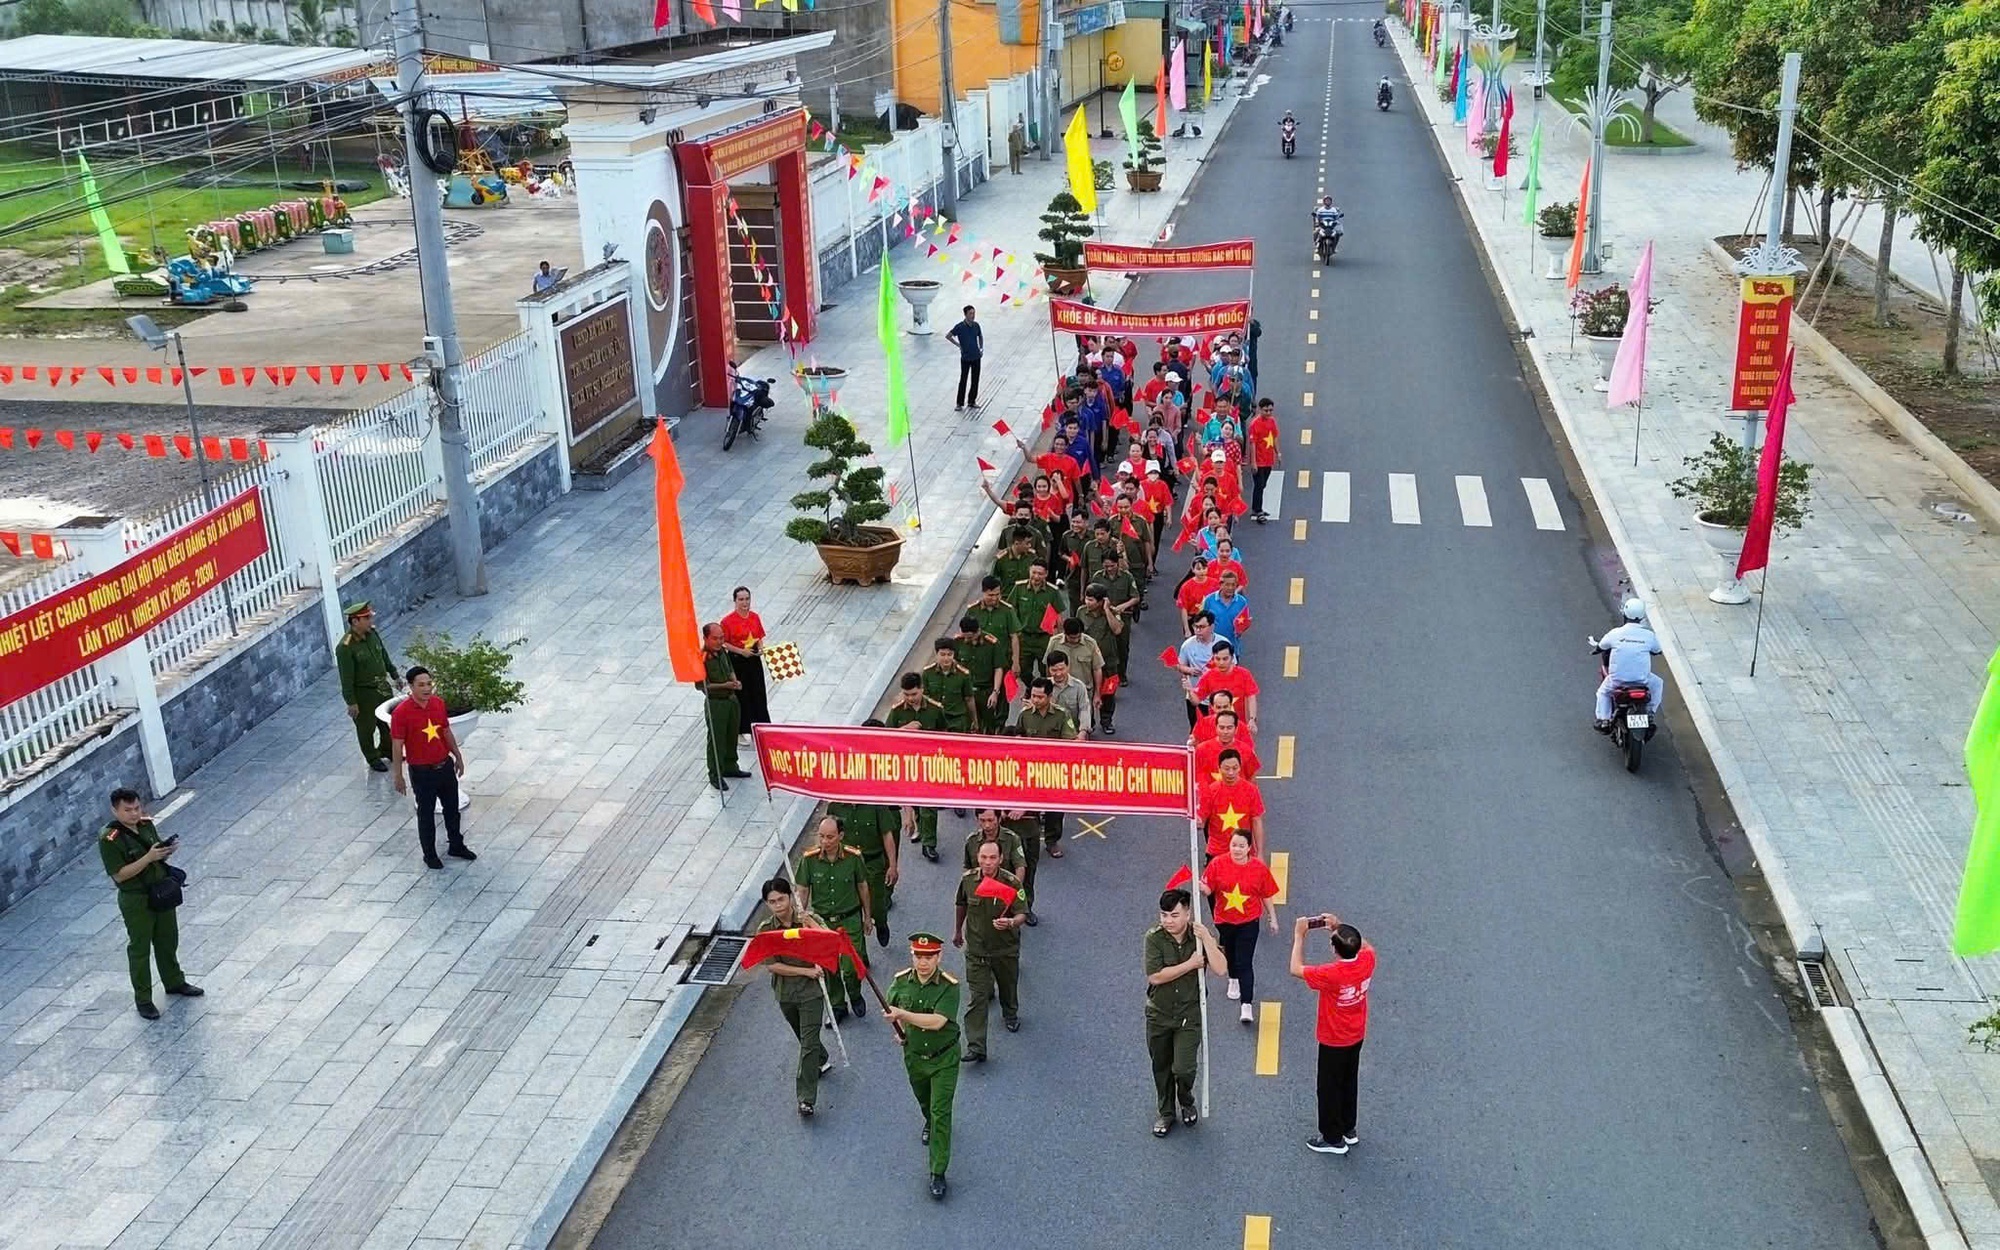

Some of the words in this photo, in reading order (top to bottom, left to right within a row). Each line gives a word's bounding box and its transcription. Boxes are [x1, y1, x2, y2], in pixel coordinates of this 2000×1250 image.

[1176, 252, 1191, 263] THEO
[1057, 307, 1082, 324] KHỎE
[1100, 313, 1119, 326] XÂY
[1121, 315, 1149, 330] DỰNG
[1151, 314, 1164, 327] VÀ
[1166, 313, 1186, 327] BẢO
[1188, 312, 1200, 330] VỆ
[1203, 309, 1216, 327] TỔ
[1217, 307, 1244, 326] QUỐC
[29, 610, 55, 641] LIỆT
[55, 596, 88, 628] CHÀO
[88, 580, 122, 613] MỪNG
[121, 570, 139, 597] ĐẠI
[137, 560, 153, 588] HỘI
[152, 554, 168, 578] ĐẠI
[167, 537, 186, 569] BIỂU
[185, 529, 207, 558] ĐẢNG
[206, 519, 218, 546] BỘ
[218, 513, 229, 538] XÃ
[227, 507, 243, 533] TÂN
[242, 499, 256, 528] TRỤ
[78, 625, 103, 657] LẦN
[102, 613, 125, 645] THỨ
[124, 613, 133, 634] I,
[131, 595, 161, 629] NHIỆM
[159, 584, 172, 612] KỲ
[171, 576, 191, 604] 2025
[195, 560, 214, 589] 2030
[768, 748, 793, 777] HỌC
[793, 745, 817, 783] TẬP
[820, 746, 837, 779] VÀ
[840, 747, 866, 780] LÀM
[869, 753, 900, 782] THEO
[903, 752, 920, 782] TƯ
[921, 747, 965, 788] TƯỞNG,
[967, 758, 992, 791] ĐẠO
[995, 754, 1024, 791] ĐỨC,
[1026, 761, 1068, 790] PHONG
[1071, 759, 1104, 791] CÁCH
[1107, 758, 1124, 793] HỒ
[1127, 762, 1148, 793] CHÍ
[1151, 768, 1184, 795] MINH
